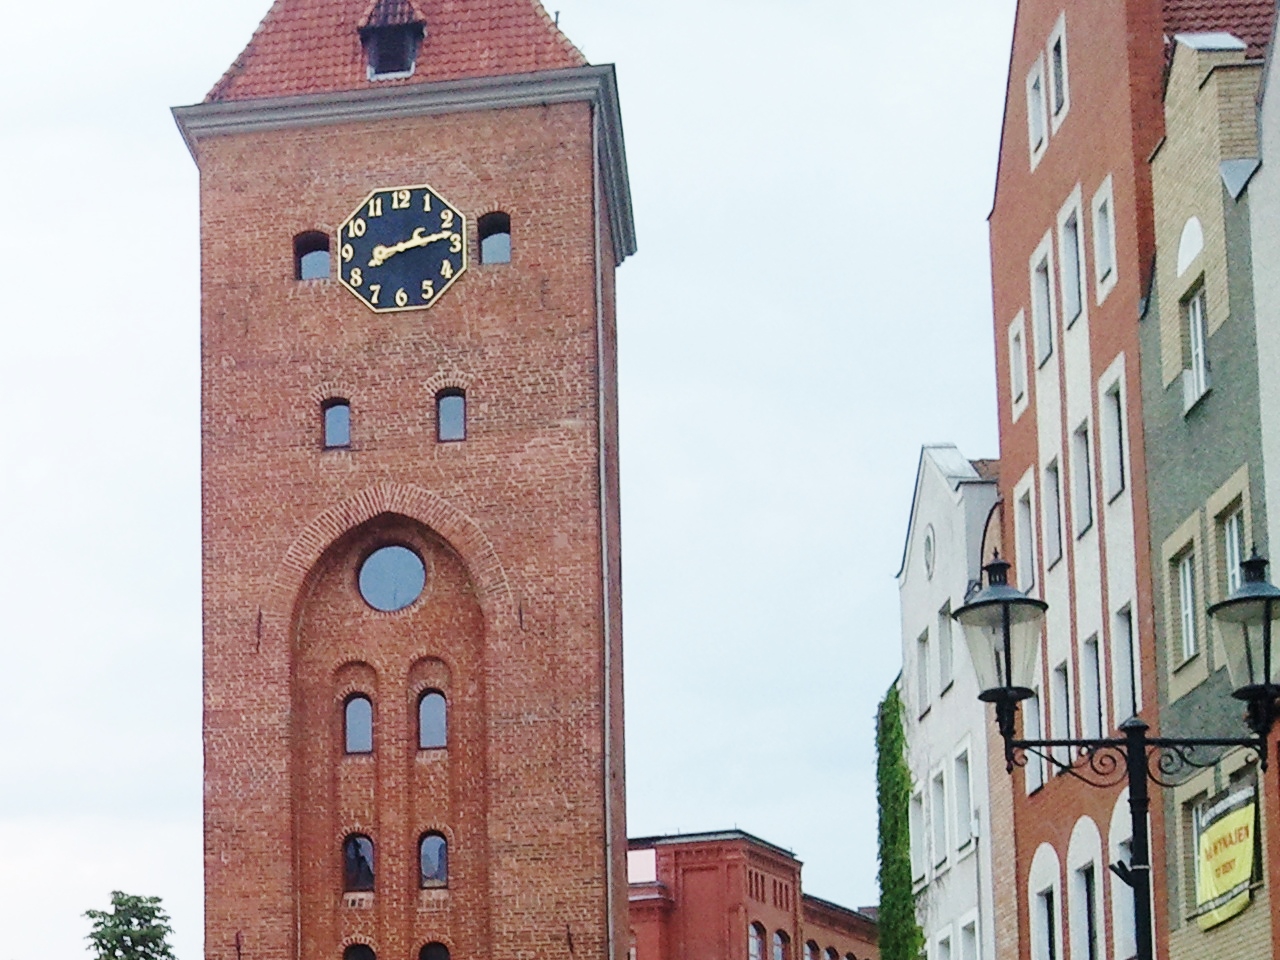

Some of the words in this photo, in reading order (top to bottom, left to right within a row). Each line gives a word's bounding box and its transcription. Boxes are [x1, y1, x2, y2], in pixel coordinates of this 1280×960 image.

[368, 197, 382, 217] 11
[392, 190, 411, 209] 12
[423, 193, 432, 212] 1
[348, 218, 366, 238] 10
[440, 209, 453, 228] 2
[341, 243, 354, 262] 9
[449, 233, 461, 253] 3
[350, 267, 363, 287] 8
[440, 259, 453, 279] 4
[369, 284, 381, 304] 7
[395, 287, 408, 307] 6
[421, 280, 434, 300] 5
